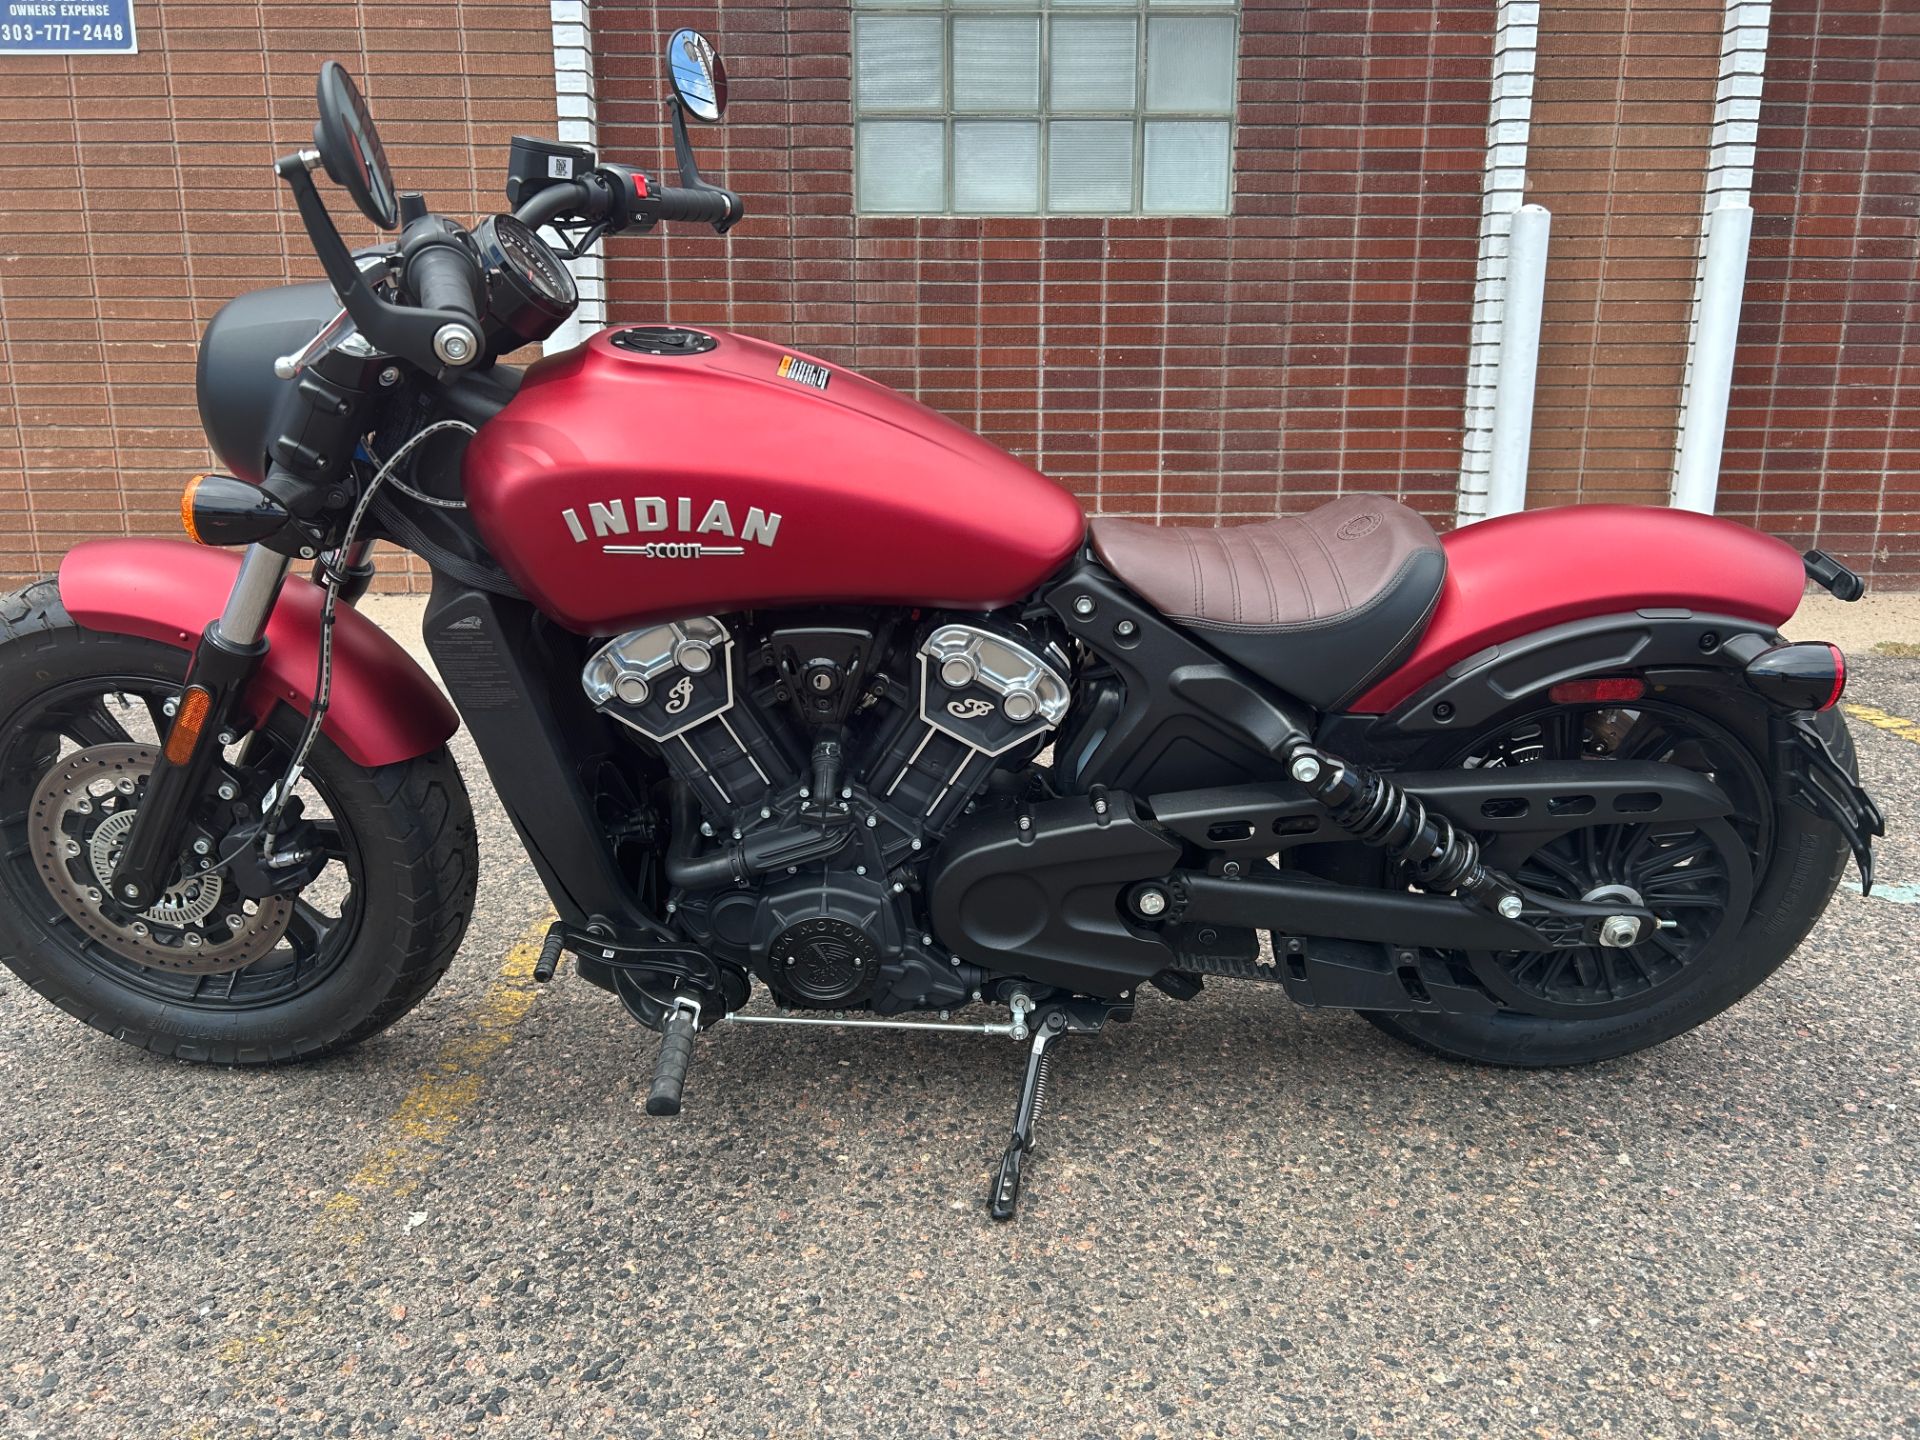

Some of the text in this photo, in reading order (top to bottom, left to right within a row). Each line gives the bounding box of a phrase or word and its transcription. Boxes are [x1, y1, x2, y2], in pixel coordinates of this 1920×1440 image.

[9, 4, 110, 16] OWNERS EXPENSE
[1, 24, 123, 41] 303-777-2448
[561, 496, 782, 547] INDIAN
[646, 542, 702, 558] SCOUT
